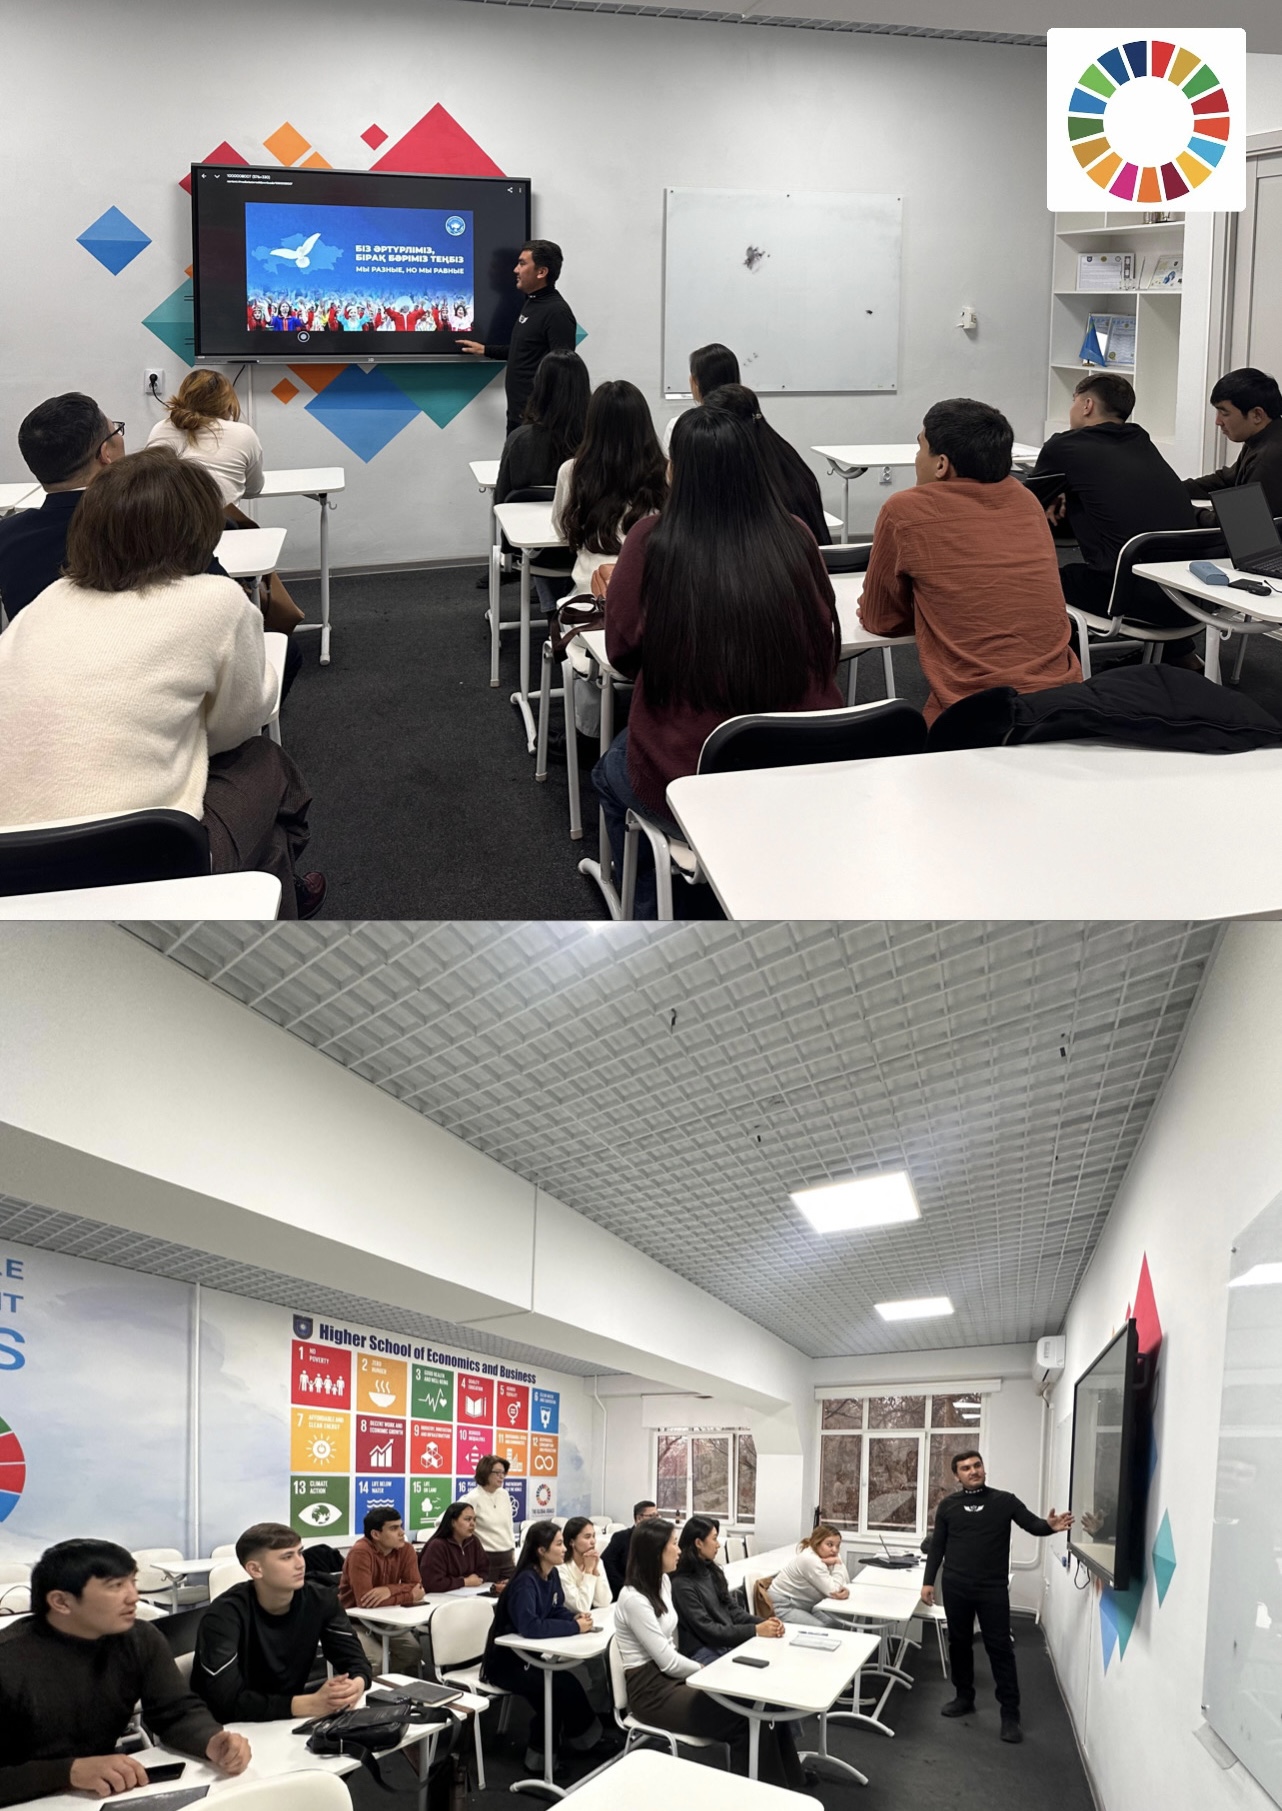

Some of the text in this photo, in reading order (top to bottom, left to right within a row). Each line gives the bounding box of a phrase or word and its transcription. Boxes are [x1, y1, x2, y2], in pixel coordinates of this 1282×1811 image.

[355, 244, 372, 252] БІЗ
[355, 254, 386, 262] БІРАҚ
[430, 256, 464, 264] ТЕҢБІЗ
[298, 1346, 304, 1360] 1
[320, 1323, 536, 1384] Higher School of Economics and Business
[362, 1358, 368, 1372] 2
[416, 1368, 421, 1380] 3
[461, 1378, 466, 1388] 4
[500, 1385, 505, 1395] 5
[297, 1412, 304, 1427] 7
[361, 1419, 367, 1432] 8
[414, 1424, 419, 1436] 9
[460, 1429, 467, 1440] 10
[293, 1480, 306, 1495] 13
[359, 1481, 369, 1494] 14
[413, 1481, 421, 1493] 15
[458, 1481, 466, 1493] 16
